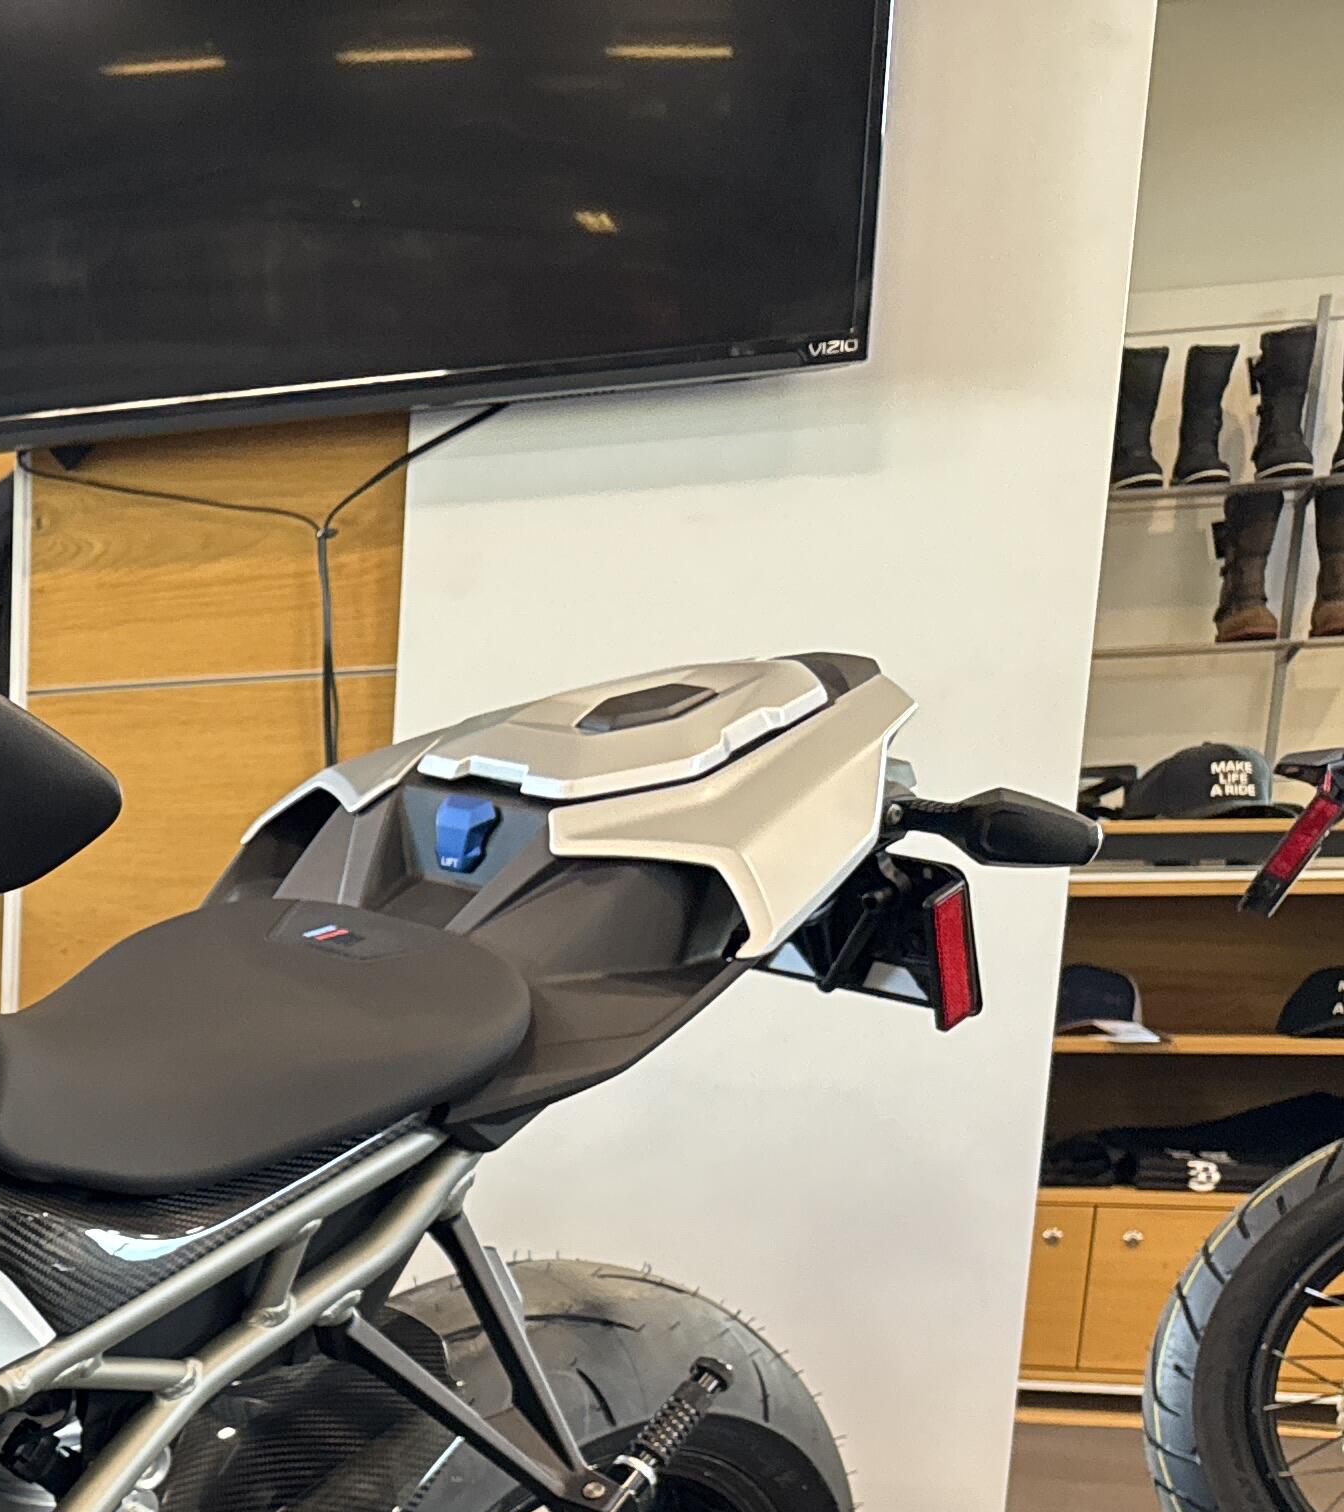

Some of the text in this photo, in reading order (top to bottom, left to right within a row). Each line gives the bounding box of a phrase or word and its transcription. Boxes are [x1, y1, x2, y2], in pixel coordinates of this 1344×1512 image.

[808, 338, 859, 357] VIZIO
[1210, 760, 1253, 775] MAKE
[1218, 772, 1248, 785] LIFE
[1210, 783, 1256, 798] A RIDE
